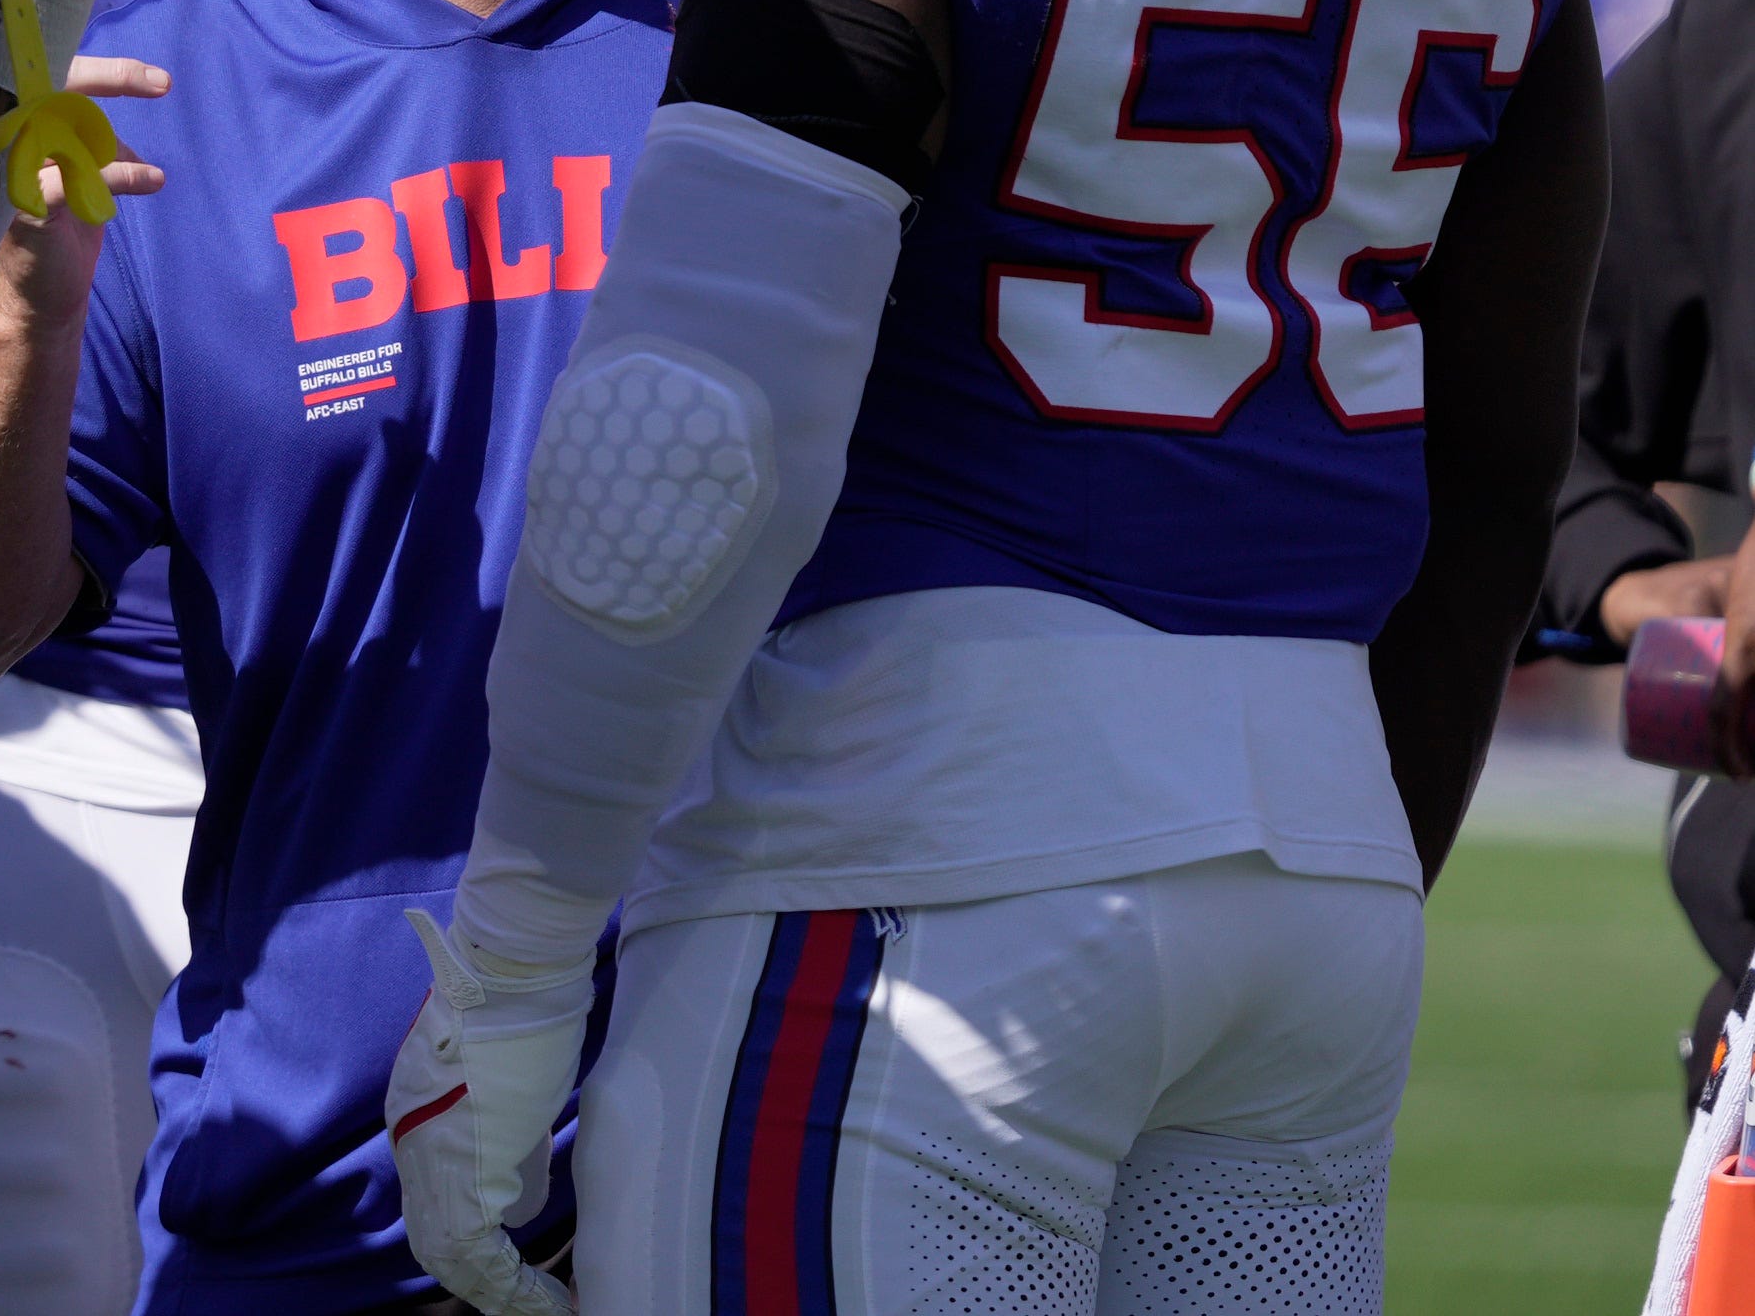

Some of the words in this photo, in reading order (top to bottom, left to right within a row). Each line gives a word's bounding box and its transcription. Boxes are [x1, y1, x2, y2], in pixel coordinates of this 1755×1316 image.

[298, 349, 376, 377] ENGINEERED
[377, 342, 403, 359] FOR
[300, 368, 356, 391] BUFFALO
[357, 360, 393, 379] BILLS
[306, 396, 365, 422] AFC-EAST
